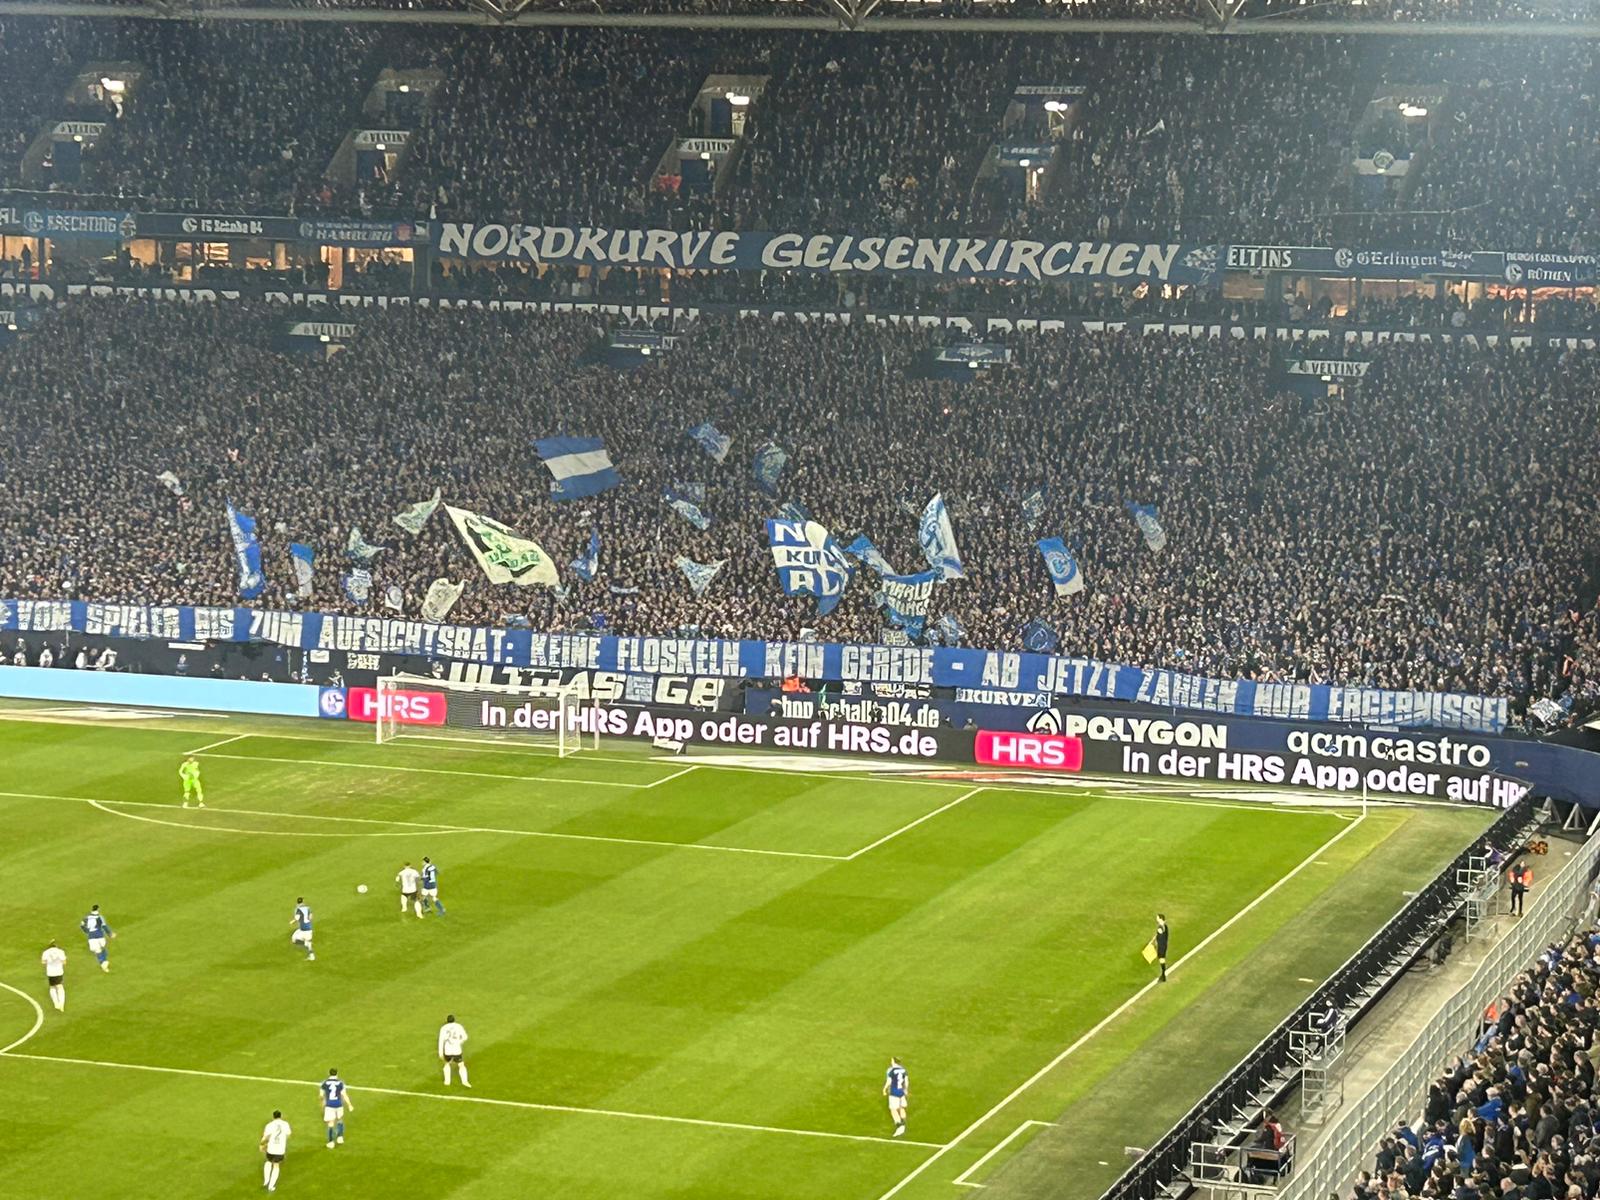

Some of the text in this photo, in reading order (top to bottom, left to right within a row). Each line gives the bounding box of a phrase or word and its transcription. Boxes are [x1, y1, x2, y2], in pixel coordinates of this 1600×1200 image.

[439, 223, 1180, 281] NORDKURVE GELSENKIRCHEN
[17, 600, 72, 631] VON
[318, 615, 513, 664] AUFSICHTSRAT:
[530, 632, 600, 669] KEINE
[764, 642, 824, 679] KEIN
[841, 645, 935, 684] GEREDE
[981, 652, 1020, 689] AB
[1036, 657, 1121, 698] JETZT
[363, 693, 431, 719] HRS
[481, 701, 938, 757] In der HRS App oder auf HRS.de
[1065, 713, 1228, 749] POLYGON
[991, 736, 1065, 765] HRS
[1123, 746, 1149, 773] In
[1158, 749, 1211, 779] der
[1217, 752, 1285, 783] HRS
[1291, 757, 1360, 791] App
[1366, 765, 1441, 796] oder
[1446, 774, 1491, 804] auf
